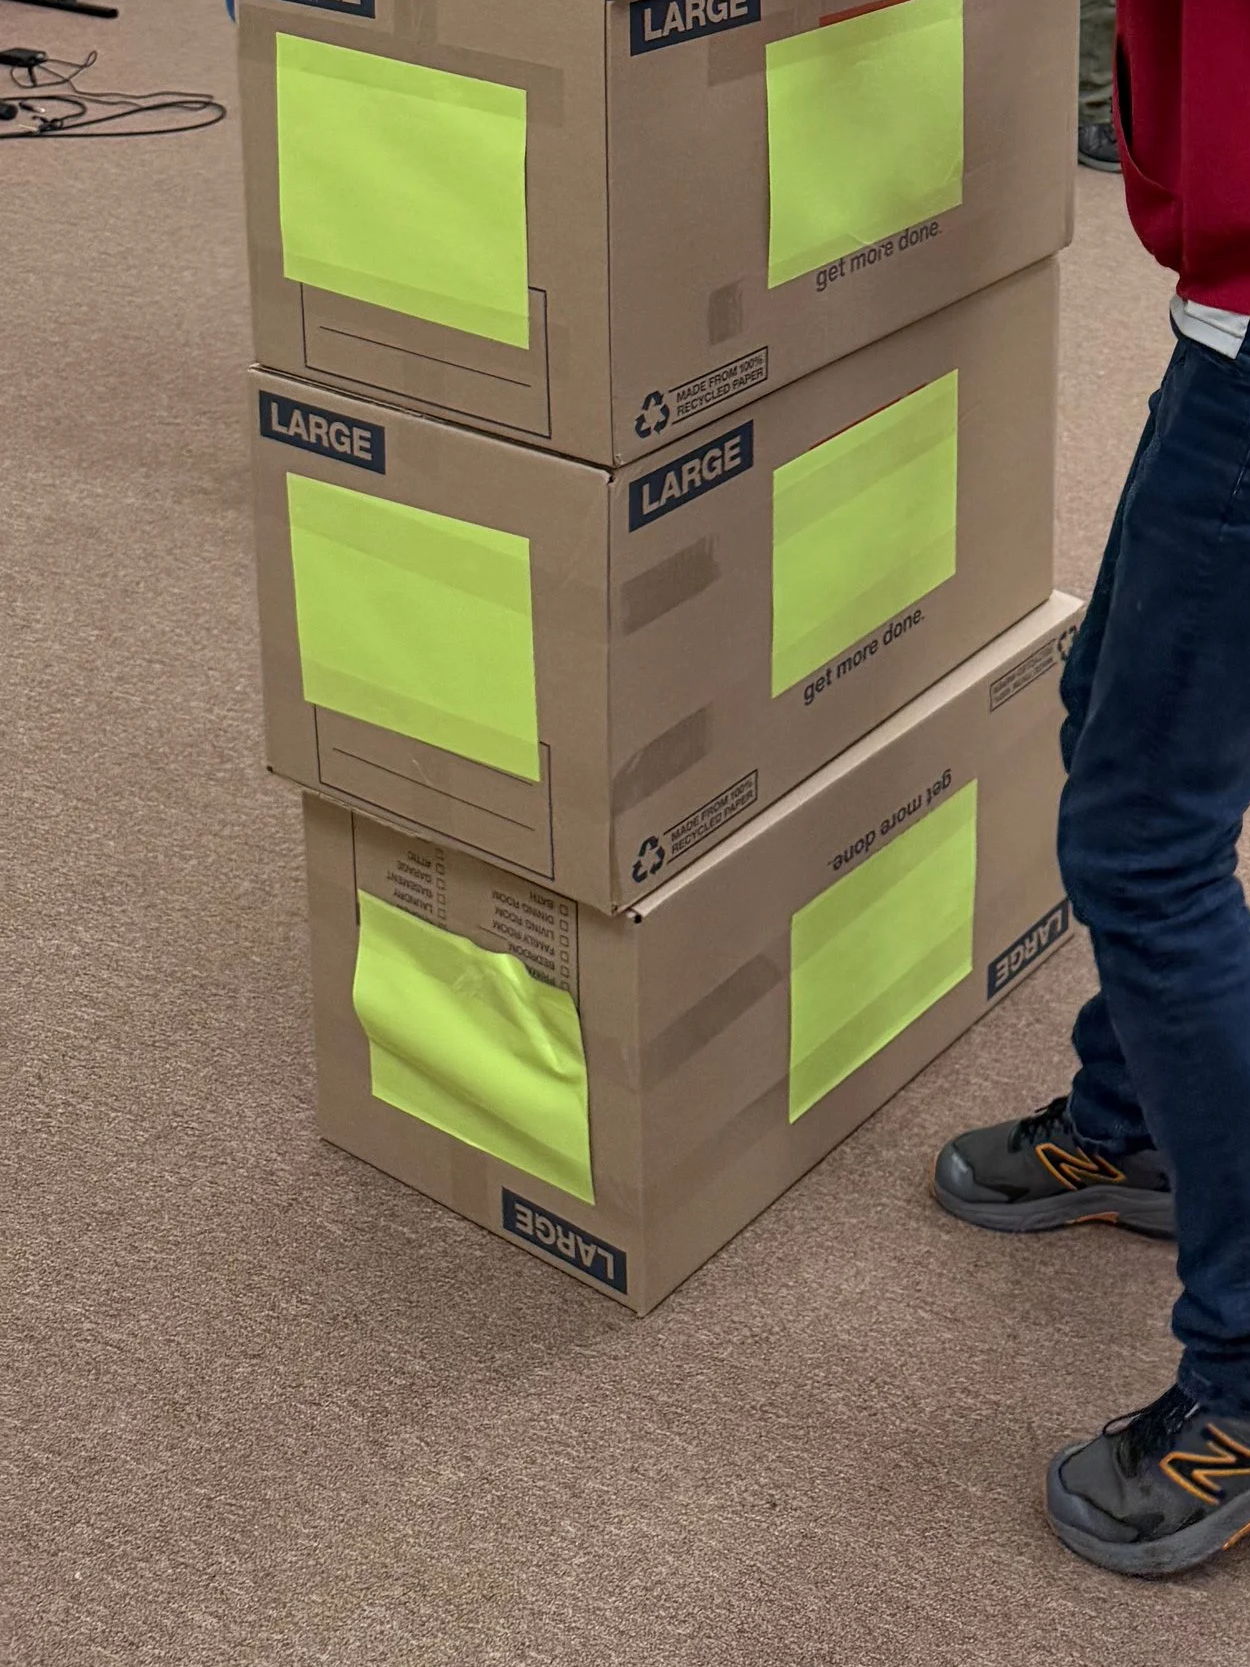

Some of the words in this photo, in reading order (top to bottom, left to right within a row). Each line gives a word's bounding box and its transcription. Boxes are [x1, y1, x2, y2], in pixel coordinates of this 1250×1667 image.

[816, 257, 845, 292] get
[850, 241, 894, 273] more
[898, 221, 943, 251] done.
[676, 379, 706, 403] MADE
[709, 366, 737, 387] FROM
[738, 355, 763, 372] 100%
[676, 382, 731, 417] RECYCLED
[733, 367, 763, 390] PAPER
[270, 402, 372, 460] LARGE
[642, 435, 741, 515] LARGE
[804, 668, 832, 706] get
[836, 639, 878, 678] more
[883, 609, 925, 646] done.
[926, 768, 952, 805] get
[671, 816, 700, 842] MADE
[701, 795, 728, 821] FROM
[671, 813, 722, 855] RECYCLED
[724, 790, 753, 817] PAPER
[880, 795, 922, 836] more
[827, 830, 876, 871] done.
[492, 890, 520, 909] ROOM
[495, 905, 522, 926] ROOM
[529, 891, 554, 910] BATH
[493, 919, 521, 940] ROOM
[995, 909, 1062, 988] LARGE
[513, 1203, 614, 1280] LARGE
